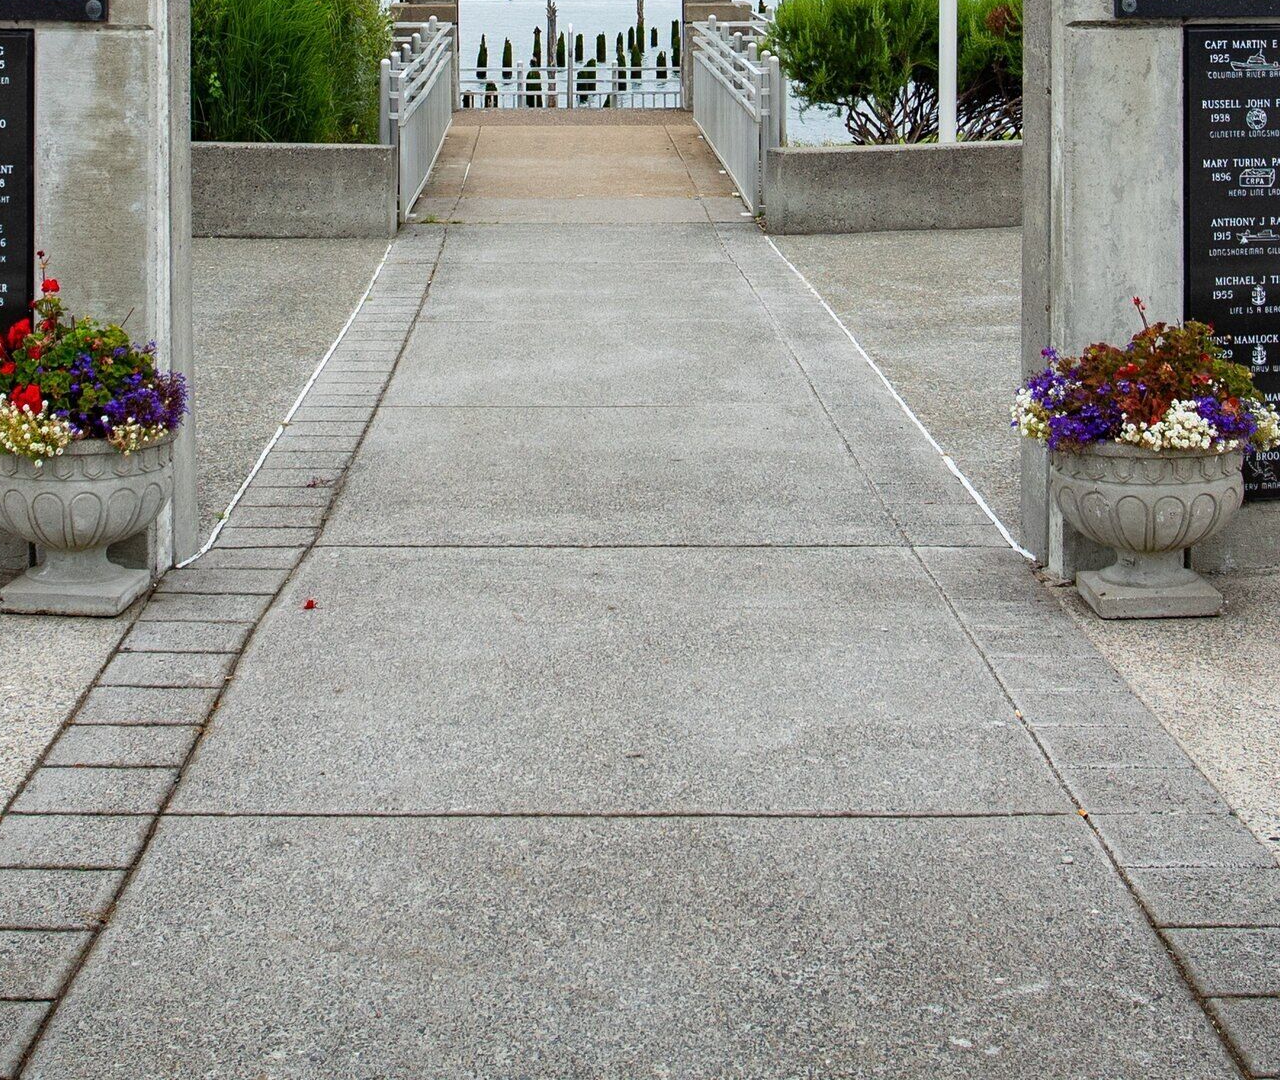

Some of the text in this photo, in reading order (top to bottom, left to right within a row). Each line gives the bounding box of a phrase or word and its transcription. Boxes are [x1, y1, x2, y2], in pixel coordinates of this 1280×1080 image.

[1202, 100, 1241, 108] RUSSELL
[1245, 99, 1271, 109] JOHN
[1211, 114, 1230, 122] 1938
[1216, 276, 1256, 285] MICHAEL
[1261, 276, 1265, 284] J
[1213, 290, 1233, 299] 1955
